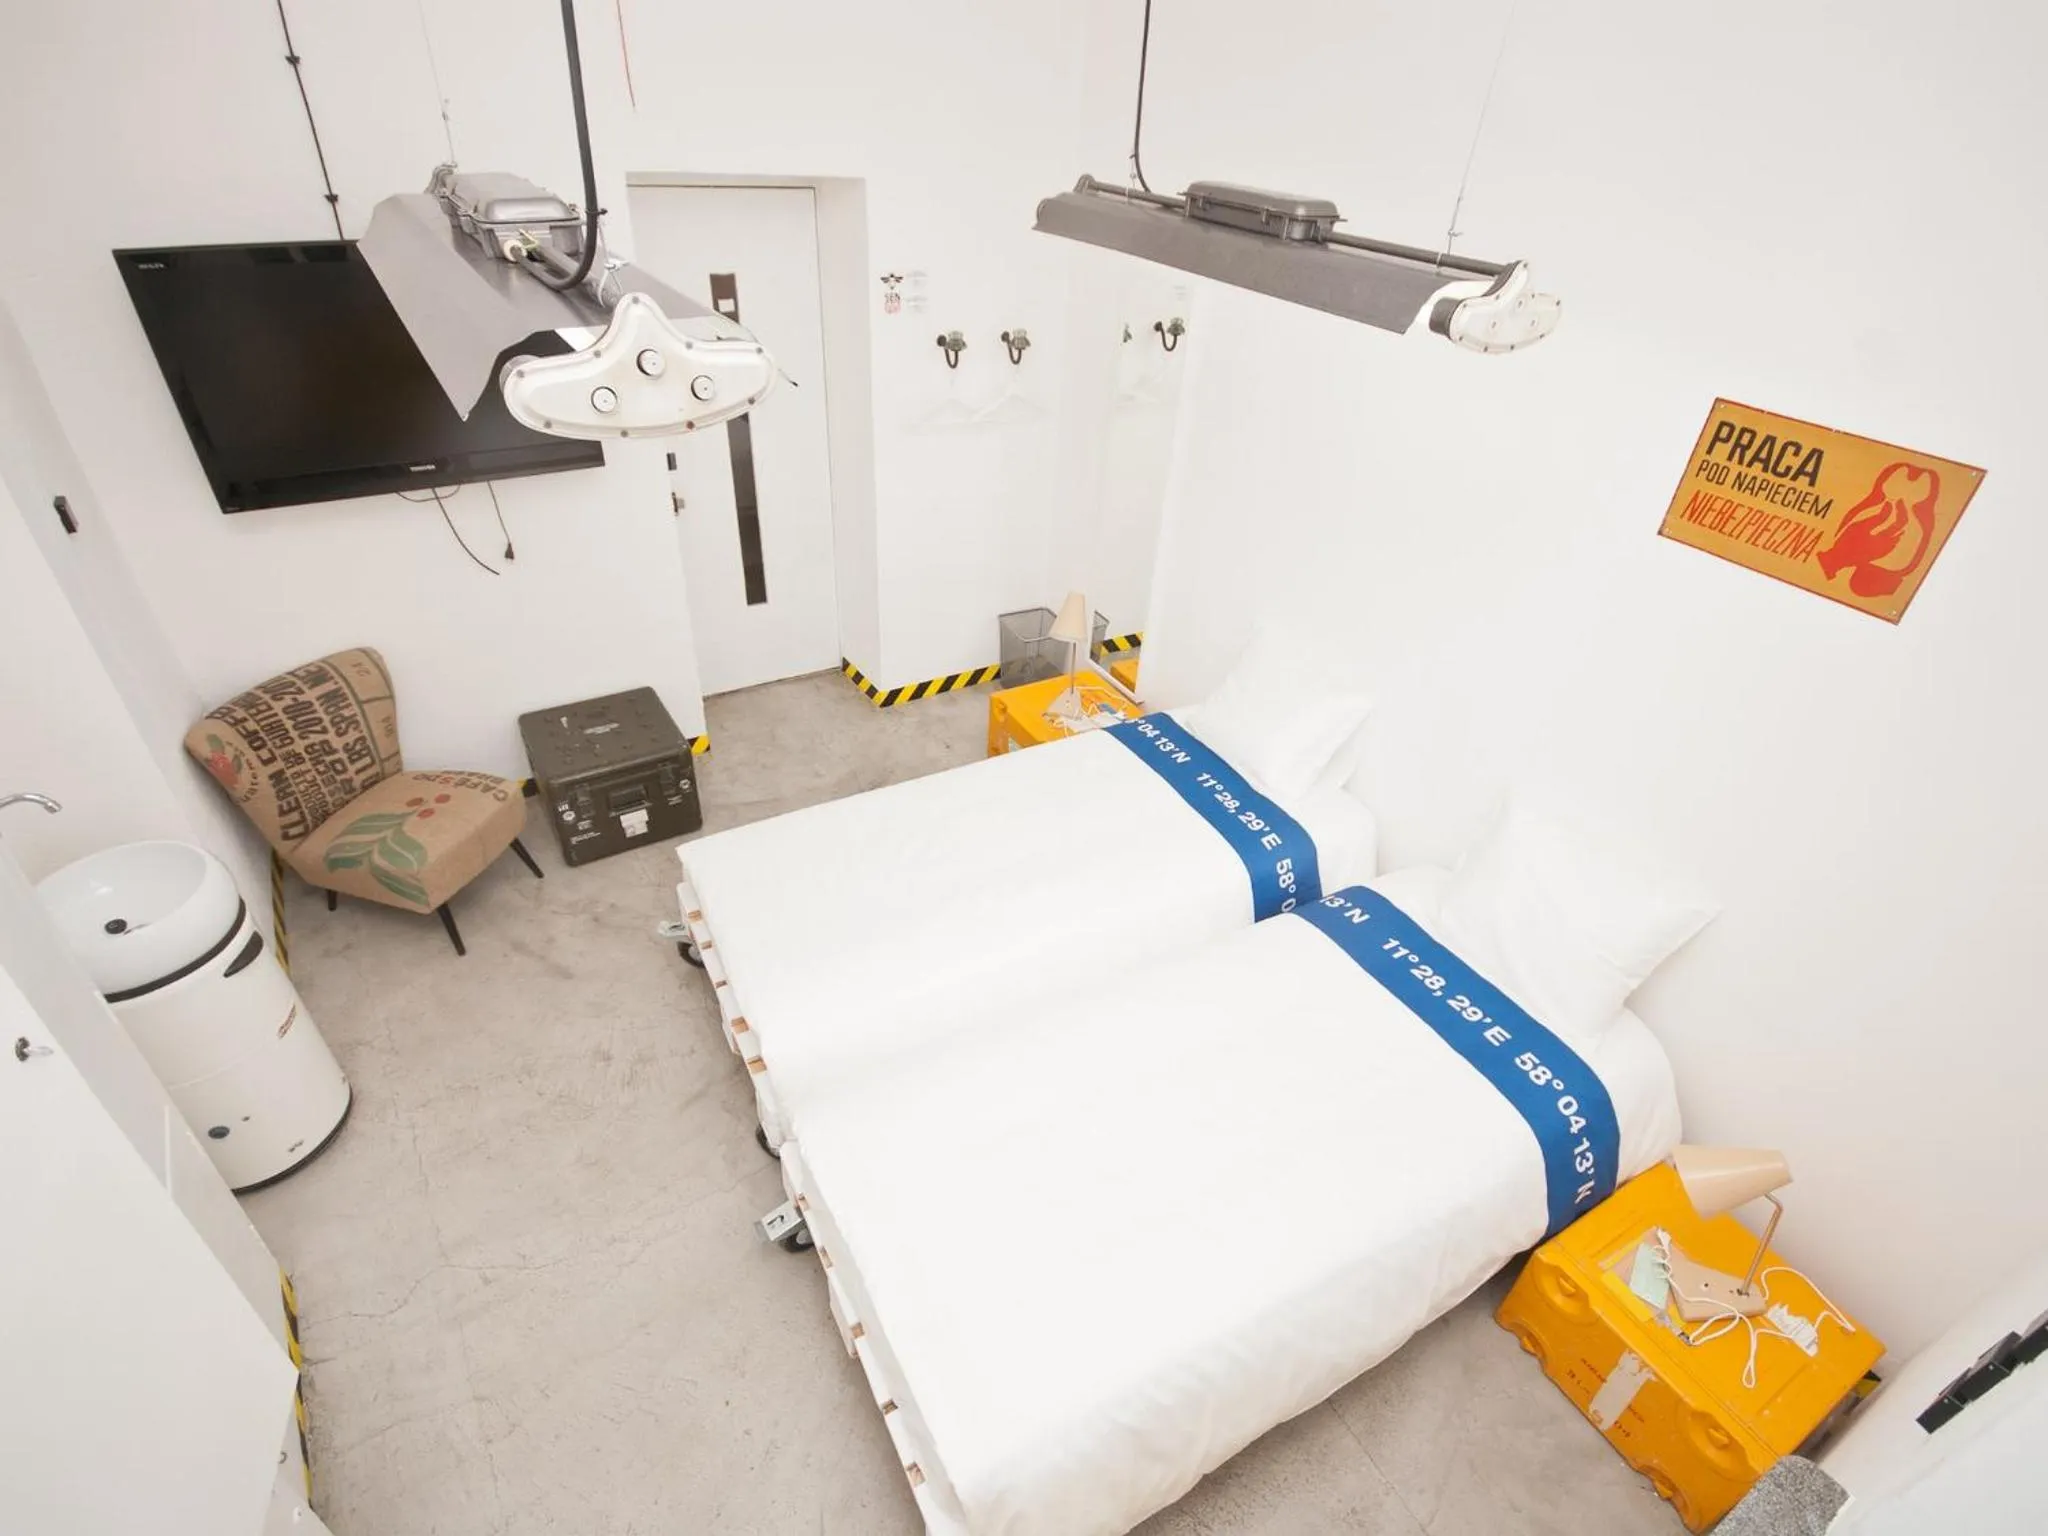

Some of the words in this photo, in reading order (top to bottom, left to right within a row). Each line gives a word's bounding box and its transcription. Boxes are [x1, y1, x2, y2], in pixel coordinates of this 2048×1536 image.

[1705, 420, 1824, 487] PRACA
[1696, 459, 1730, 486] POD
[1731, 471, 1833, 519] NAPIECIEM
[1680, 490, 1824, 561] NIEBEZPIECZNA
[267, 768, 309, 840] CLEAN
